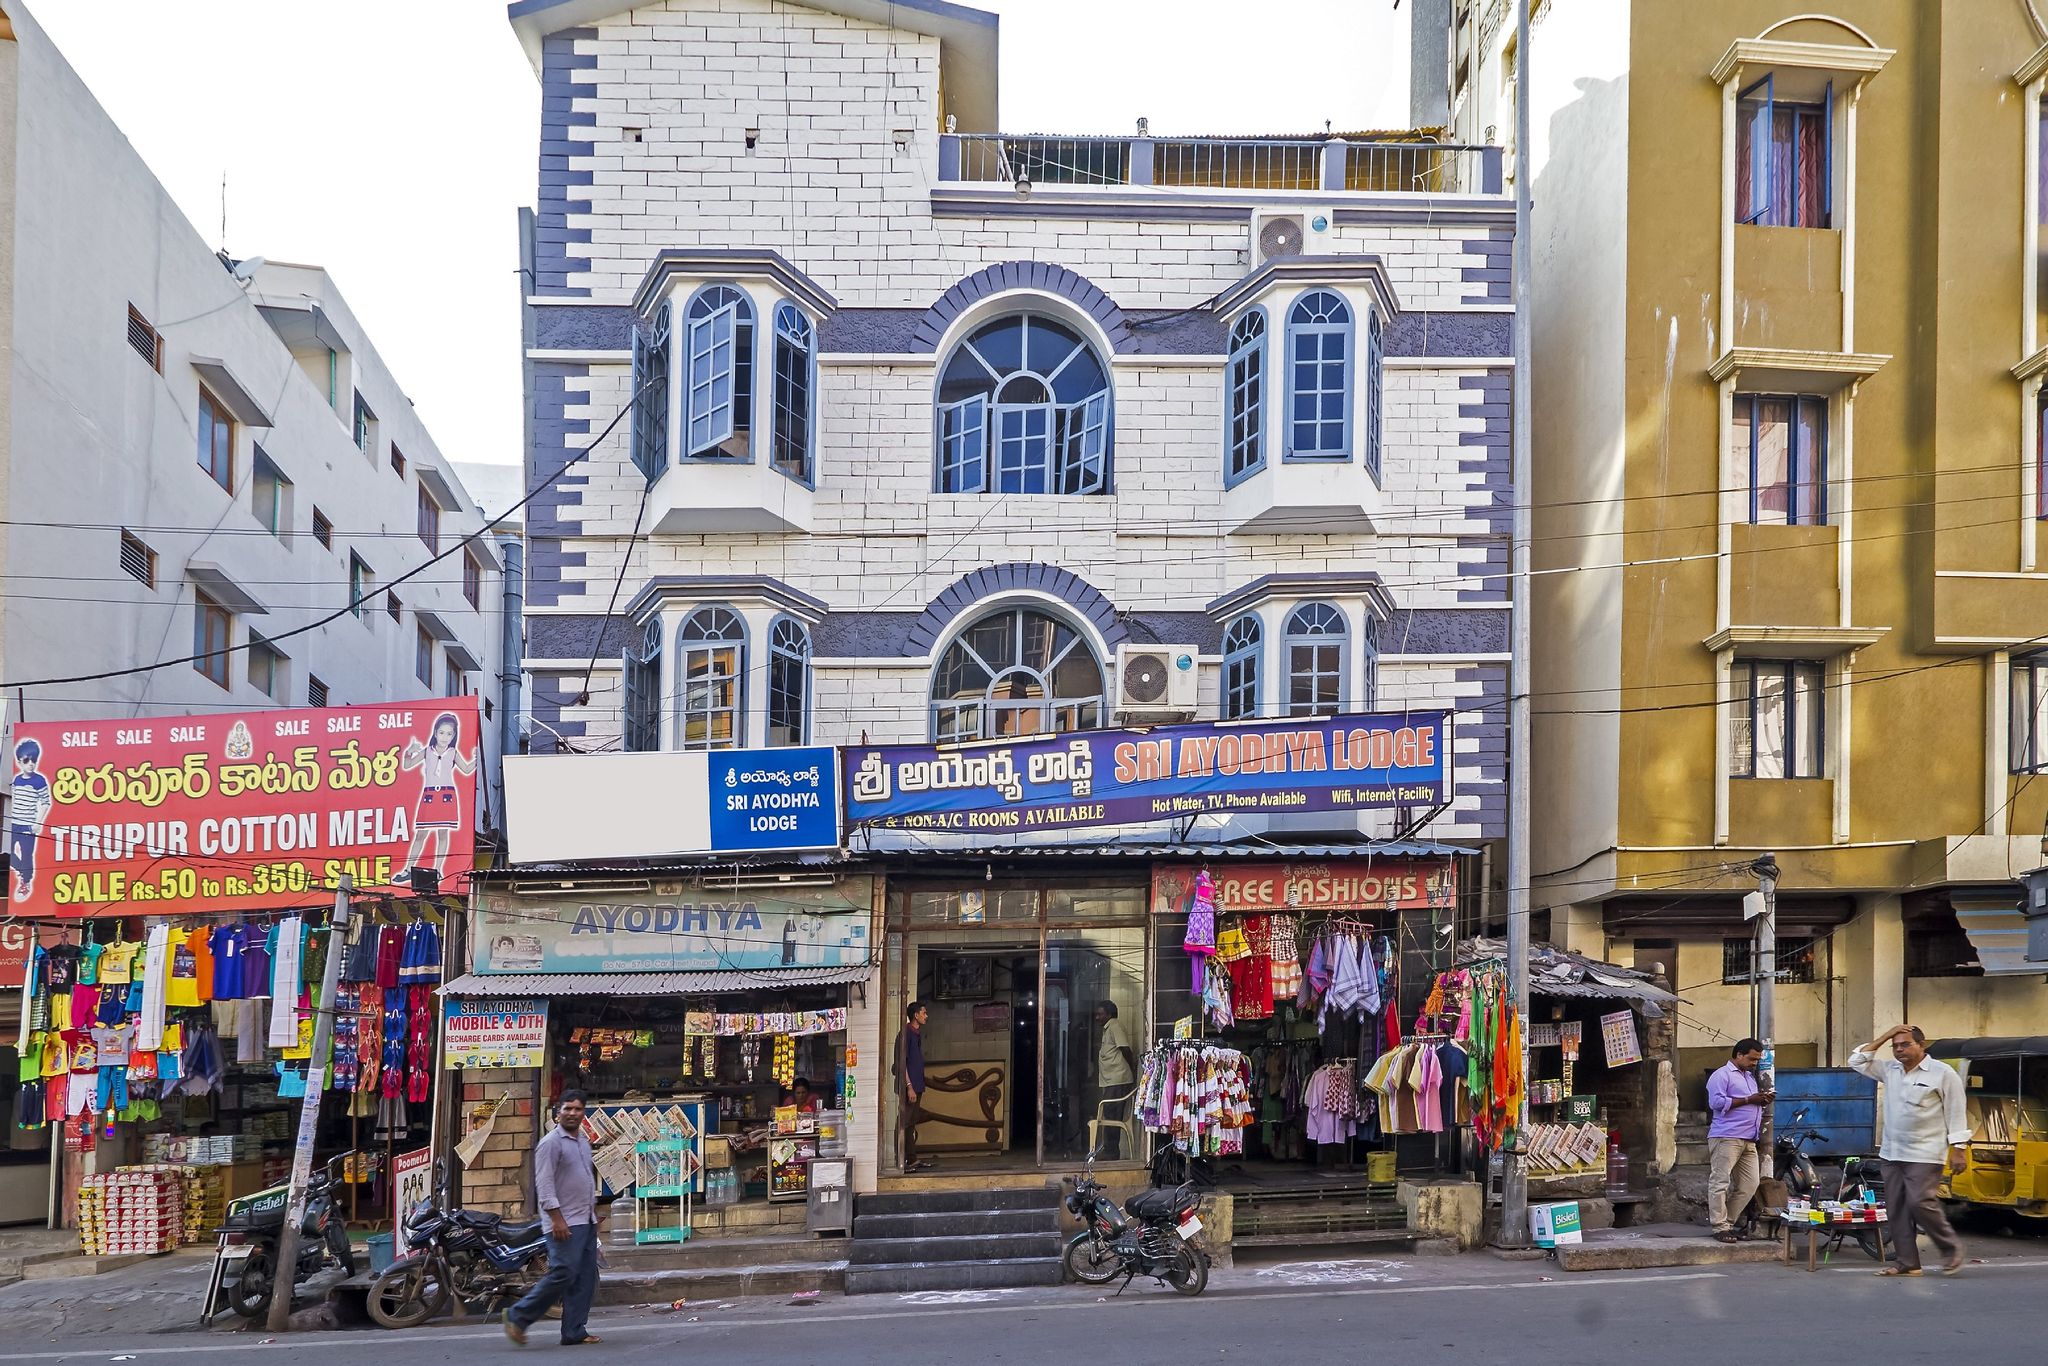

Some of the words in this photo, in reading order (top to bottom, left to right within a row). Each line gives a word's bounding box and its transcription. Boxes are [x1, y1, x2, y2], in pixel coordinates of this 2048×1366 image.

[62, 731, 98, 748] SALE
[116, 729, 152, 745] SALE
[170, 726, 206, 743] SALE
[275, 719, 310, 737] SALE
[327, 716, 361, 733] SALE
[379, 712, 412, 729] SALE
[1115, 738, 1172, 784] SRI
[1177, 730, 1327, 778] AYODHYA
[1332, 726, 1434, 770] LODGE
[52, 753, 211, 808] తిరుపూర్
[219, 746, 321, 797] కాటన్
[328, 739, 400, 790] మేళ
[724, 767, 738, 788] శ్రీ
[740, 769, 792, 787] అయోధ్య
[853, 752, 891, 802] శ్రీ
[898, 749, 1023, 801] అయోధ్య
[727, 794, 748, 811] SRI
[752, 792, 820, 810] AYODHYA
[1152, 799, 1170, 813] Hot
[1172, 797, 1205, 812] Water,
[1226, 794, 1257, 807] Phone
[1260, 791, 1306, 806] Available
[1331, 788, 1354, 805] Wifi,
[1356, 787, 1395, 802] Internet
[1398, 785, 1434, 802] Facility
[750, 815, 797, 832] LODGE
[885, 816, 898, 828] &
[903, 812, 963, 829] NON-A/C
[968, 811, 1020, 827] ROOMS
[1024, 804, 1105, 825] AVAILABLE
[51, 820, 189, 862] TIRUPUR
[199, 813, 317, 856] COTTON
[329, 806, 410, 847] MELA
[54, 871, 126, 904] SALE
[132, 868, 197, 900] Rs.50
[202, 877, 220, 897] to
[324, 855, 391, 890] SALE
[570, 901, 763, 936] AYODHYA
[461, 1001, 479, 1014] SRI
[483, 1000, 535, 1014] AYODHYA
[449, 1015, 499, 1031] MOBILE
[503, 1014, 513, 1030] &
[518, 1014, 544, 1029] DTH
[446, 1034, 481, 1043] RECHARGE
[482, 1033, 505, 1042] CARDS
[506, 1032, 542, 1041] AVAILABLE
[1573, 1107, 1591, 1115] SODA
[1555, 1210, 1577, 1225] Bisleri
